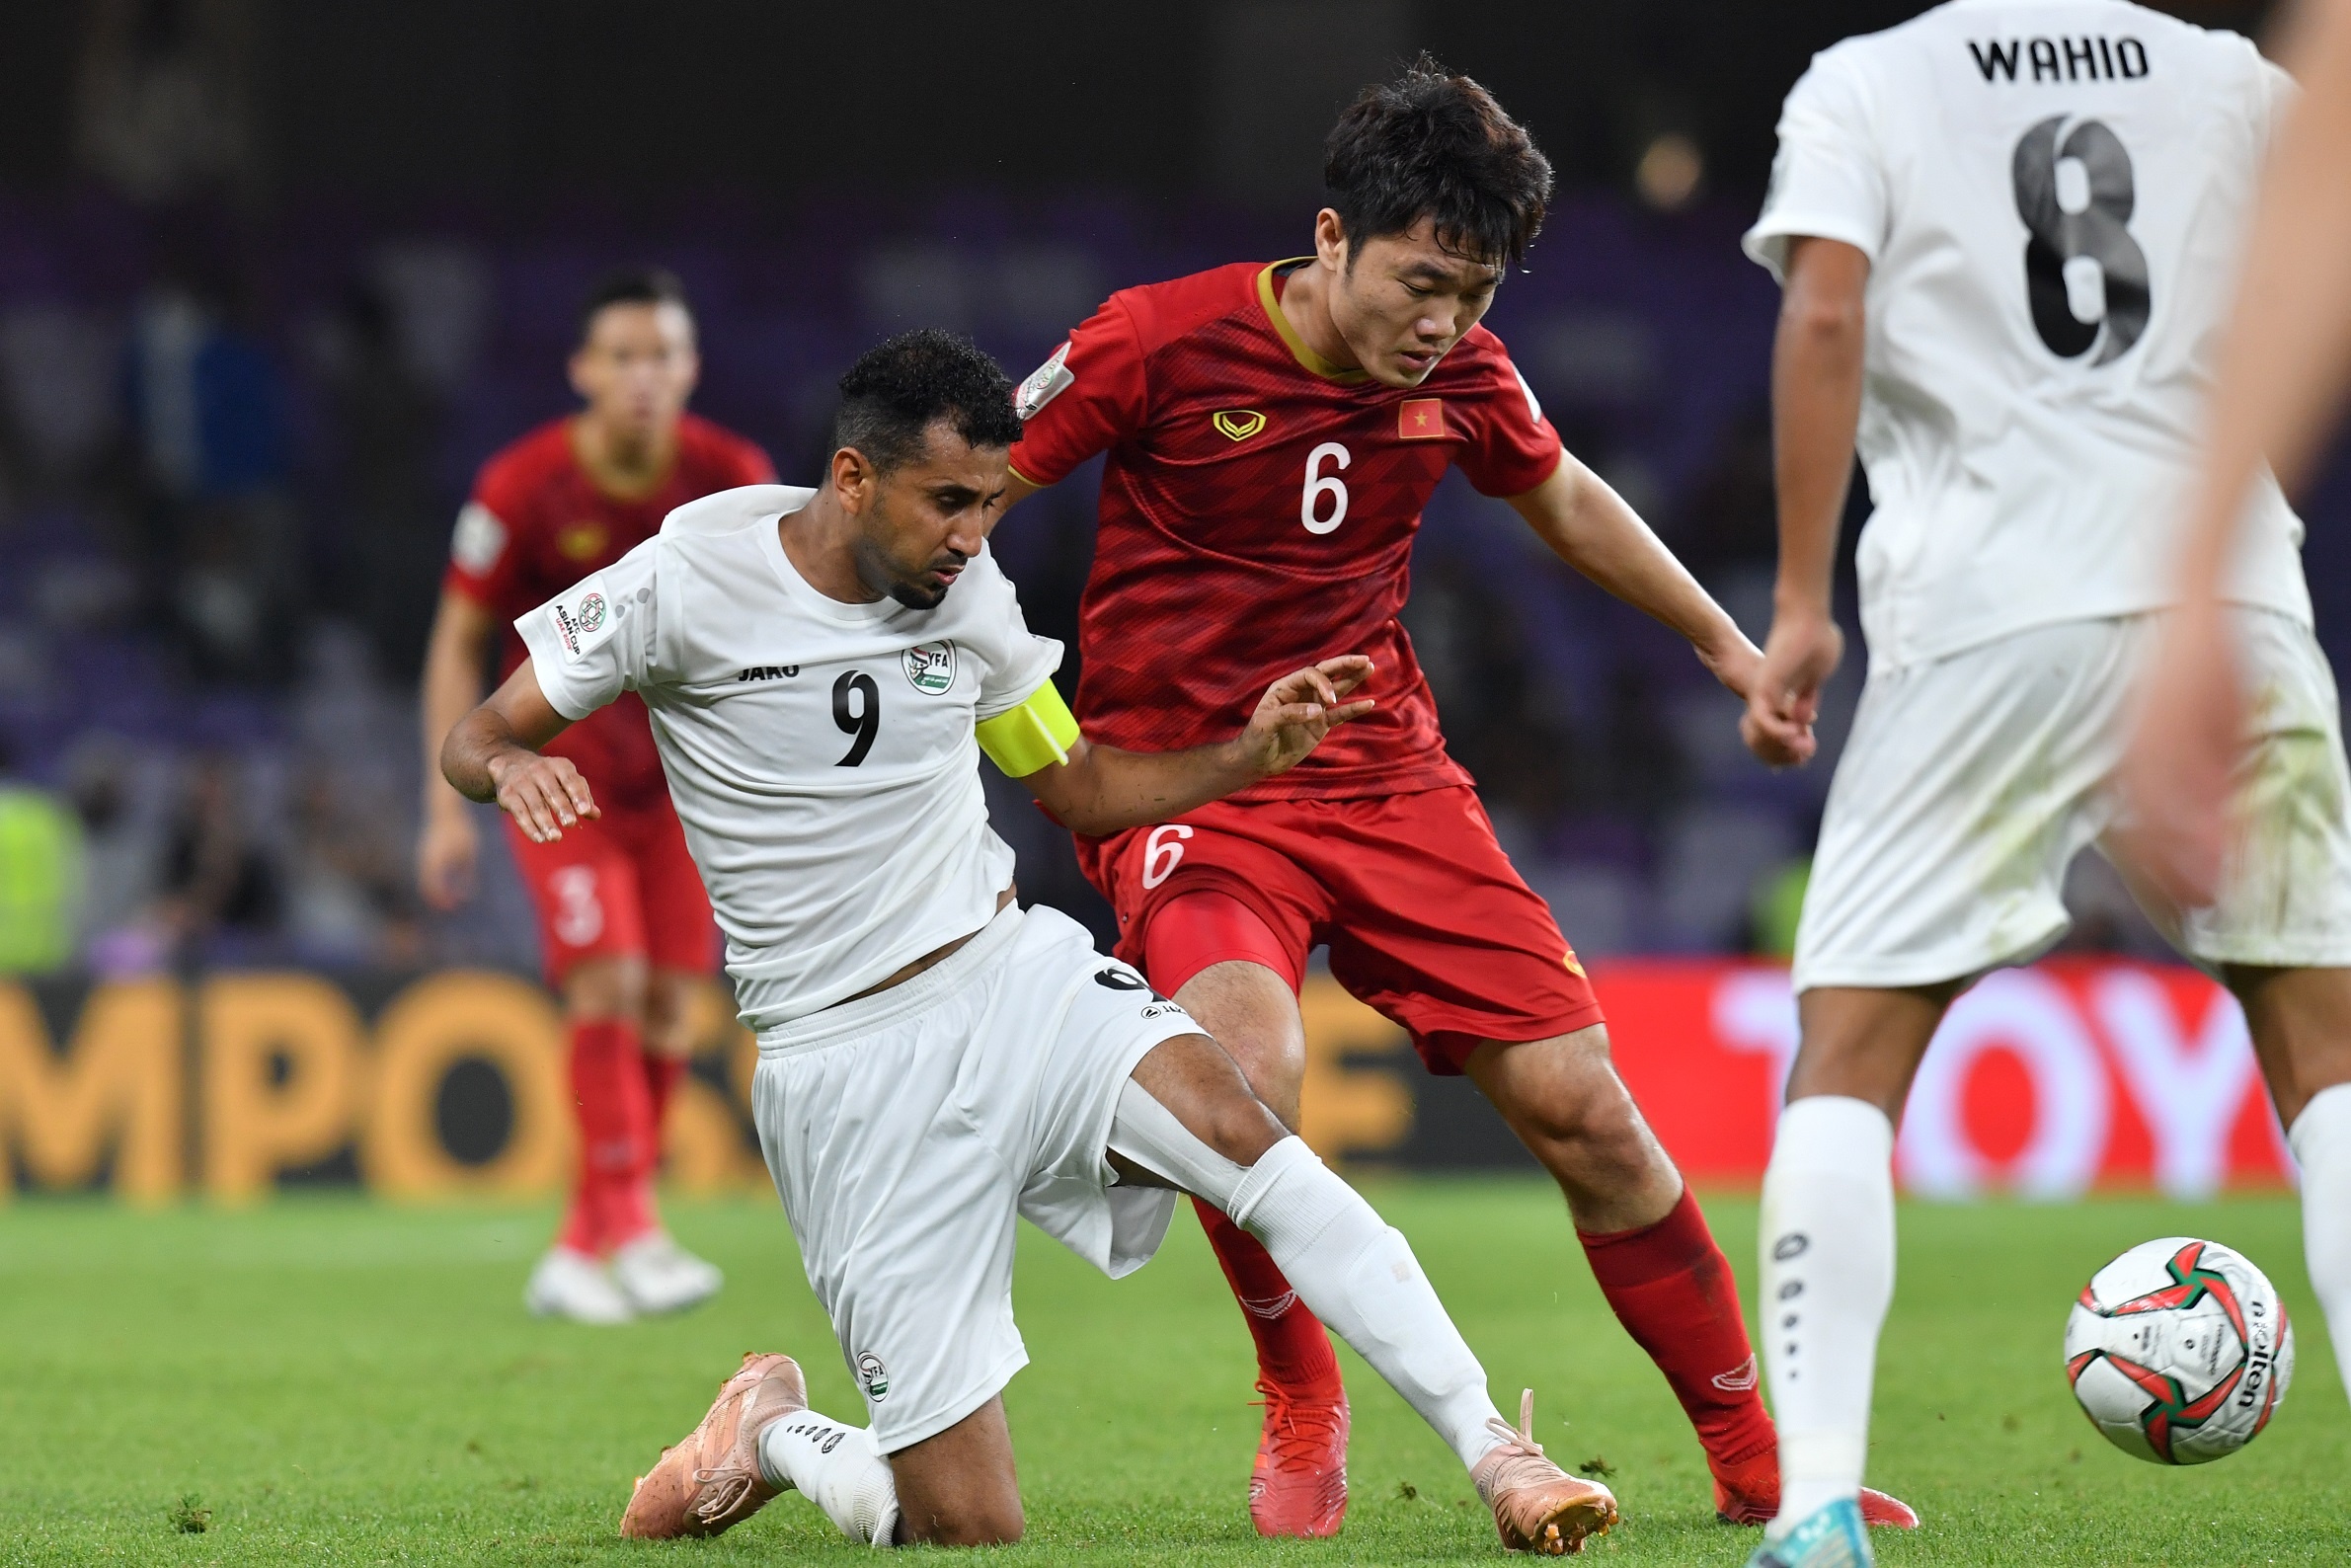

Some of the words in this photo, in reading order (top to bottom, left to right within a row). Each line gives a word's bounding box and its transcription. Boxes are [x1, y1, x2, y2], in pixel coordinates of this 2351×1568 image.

[1967, 37, 2151, 82] WAHID
[2012, 114, 2152, 368] 8
[1300, 441, 1352, 535] 6
[555, 604, 575, 634] ASIAN
[570, 635, 581, 656] CUP
[571, 617, 581, 634] AFC
[928, 652, 949, 668] YFA
[831, 669, 880, 767] 9
[1141, 823, 1195, 890] 6
[548, 864, 604, 947] 3
